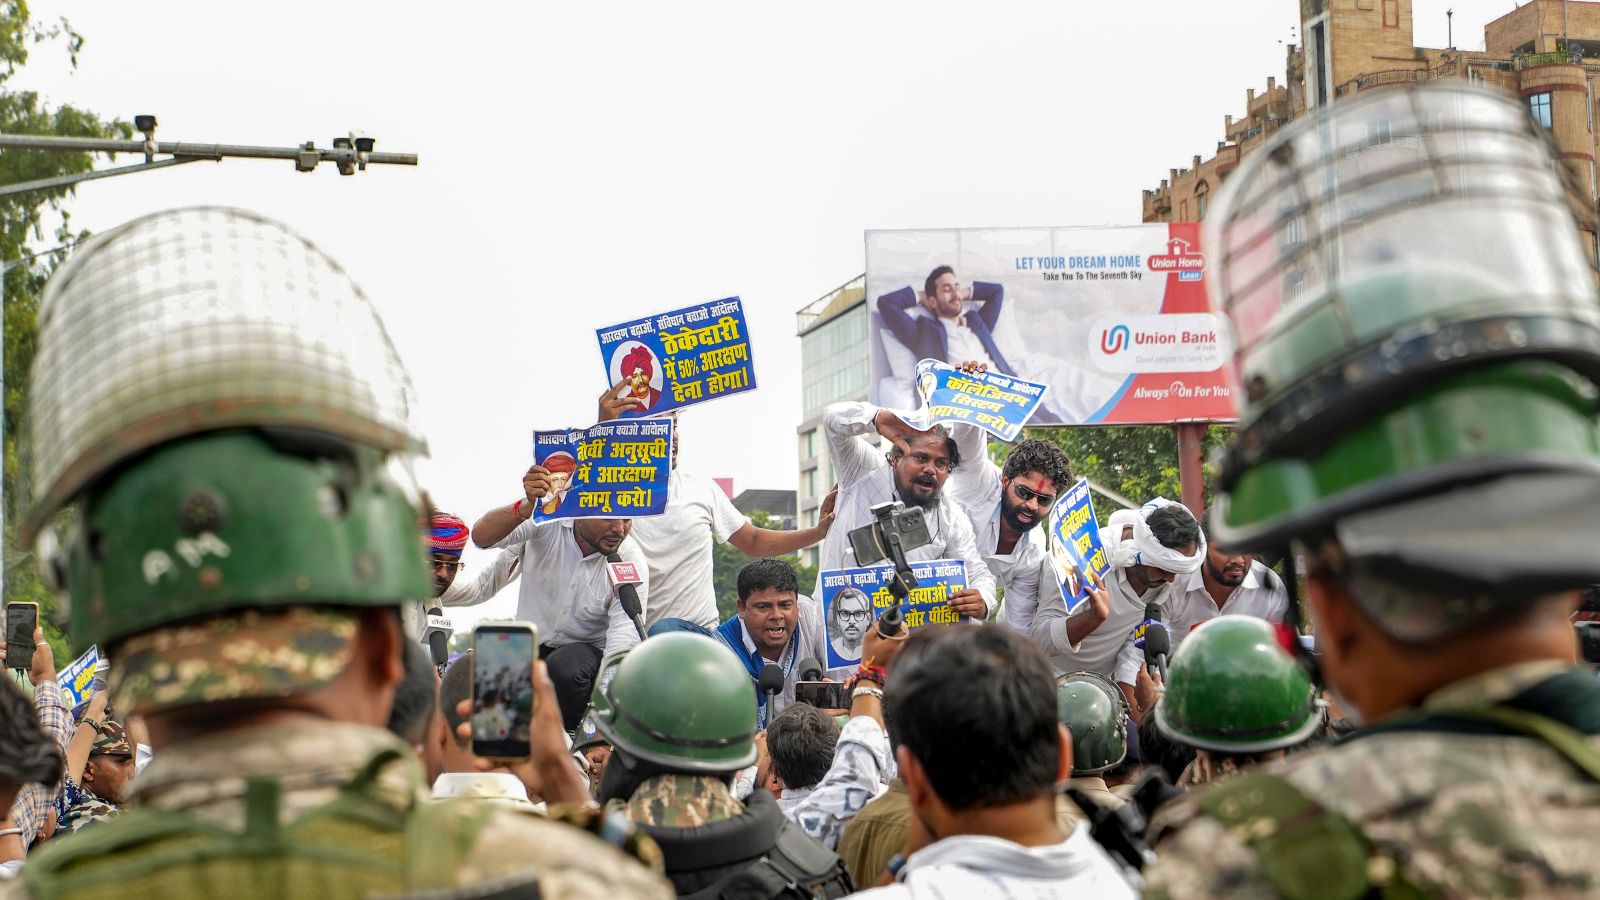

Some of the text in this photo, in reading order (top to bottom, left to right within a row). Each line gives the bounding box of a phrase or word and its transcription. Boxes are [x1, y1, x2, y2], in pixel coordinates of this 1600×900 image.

[1015, 255, 1141, 270] LET YOUR DREAM HOME
[1151, 258, 1203, 268] Union Home
[1043, 271, 1142, 281] Take You To The Seventh Sky
[1181, 271, 1200, 279] Loan
[600, 330, 630, 344] आरक्षण
[657, 313, 685, 330] संविधान
[685, 307, 709, 324] बचाओ
[710, 300, 740, 316] आंदोलन
[659, 316, 741, 355] ठेकेदारी
[1135, 331, 1216, 345] Union Bank
[663, 343, 749, 380] में 50% आरक्षण
[671, 366, 749, 403] देना होगा।
[946, 375, 1031, 407] कॉलेजियम
[1134, 385, 1230, 399] Always On For You
[537, 434, 568, 445] आरक्षण
[616, 422, 639, 435] बचाओ
[640, 422, 669, 435] आंदोलन
[576, 437, 668, 464] नौवीं अनुसूची
[578, 462, 657, 483] में आरक्षण
[578, 486, 652, 513] लागू करो।
[935, 563, 962, 577] आंदोलन
[871, 586, 903, 608] दलि
[905, 608, 925, 628] और
